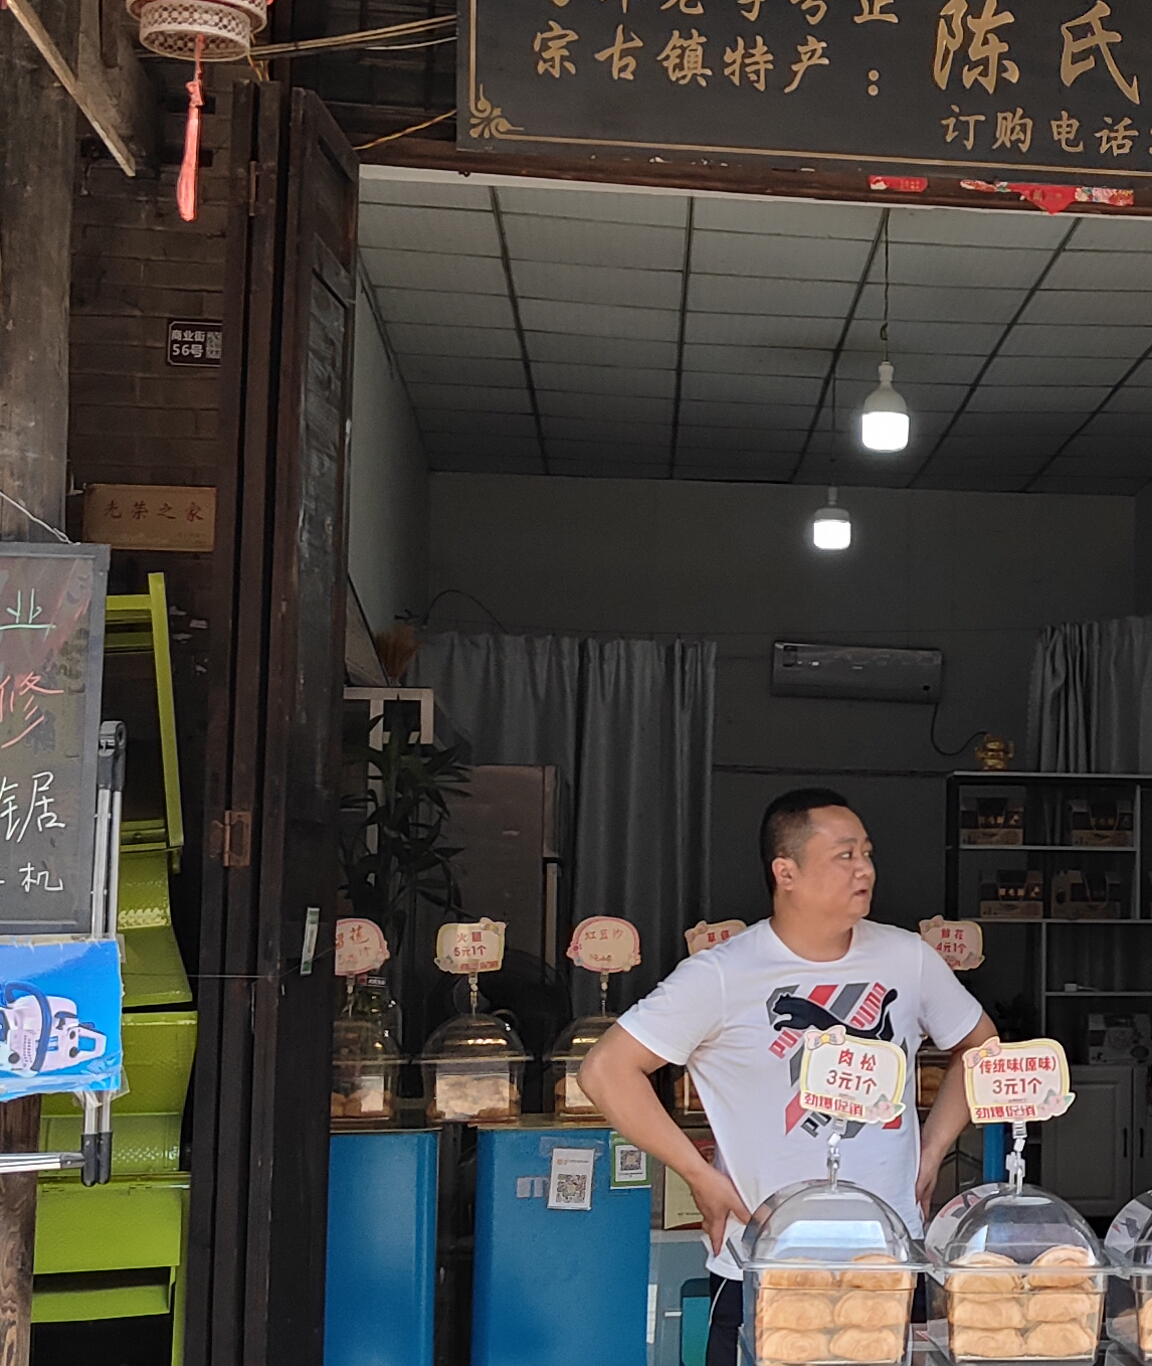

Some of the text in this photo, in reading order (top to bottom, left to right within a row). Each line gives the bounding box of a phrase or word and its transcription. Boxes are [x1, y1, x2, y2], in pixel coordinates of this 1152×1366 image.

[172, 330, 205, 342] 商业街
[172, 344, 204, 357] 56号
[103, 500, 204, 522] 光荣之家
[837, 1048, 877, 1072] 肉松
[979, 1056, 1057, 1075] 传统味(原味)
[826, 1070, 878, 1095] 3元1个
[992, 1077, 1042, 1095] 3元1个
